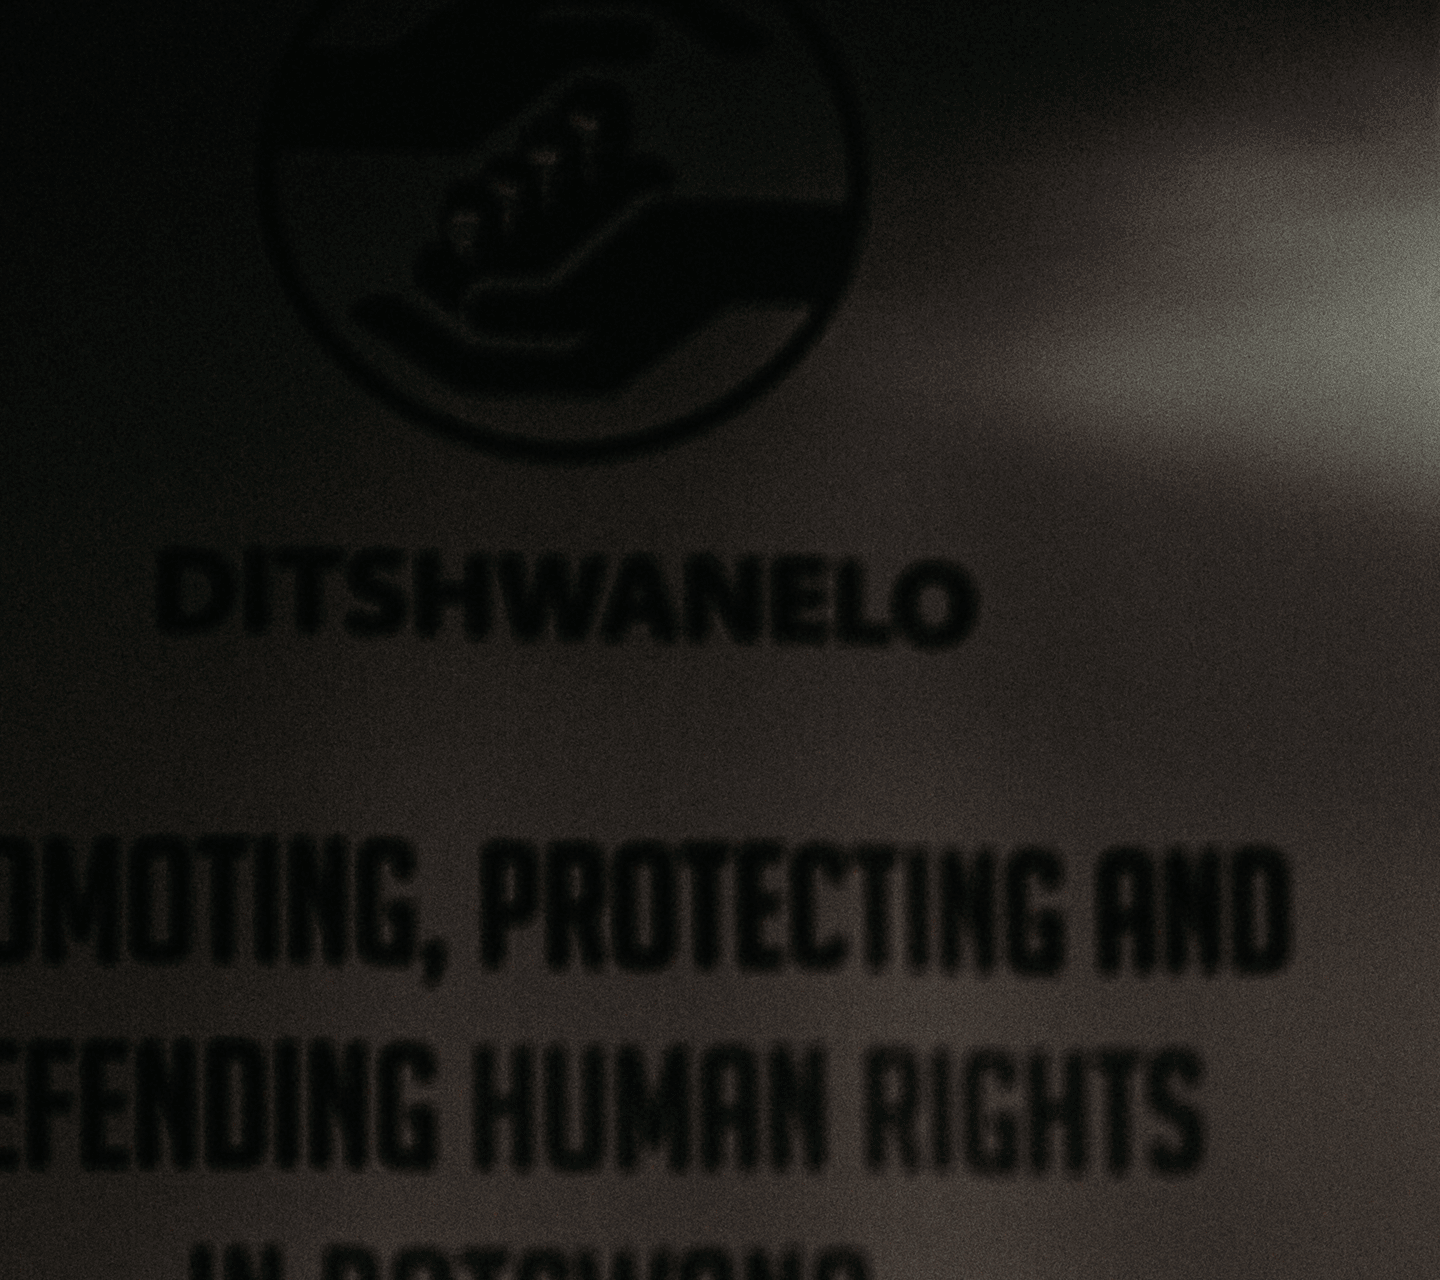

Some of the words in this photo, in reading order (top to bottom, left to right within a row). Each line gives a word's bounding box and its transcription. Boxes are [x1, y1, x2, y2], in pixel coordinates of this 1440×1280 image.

[155, 545, 980, 652] DITSHWANELO
[0, 832, 448, 988] OMOTING,
[478, 837, 1066, 976] PROTECTING
[1094, 841, 1293, 976] AND
[471, 1041, 829, 1175] HUMAN
[865, 1047, 1205, 1179] RIGHTS
